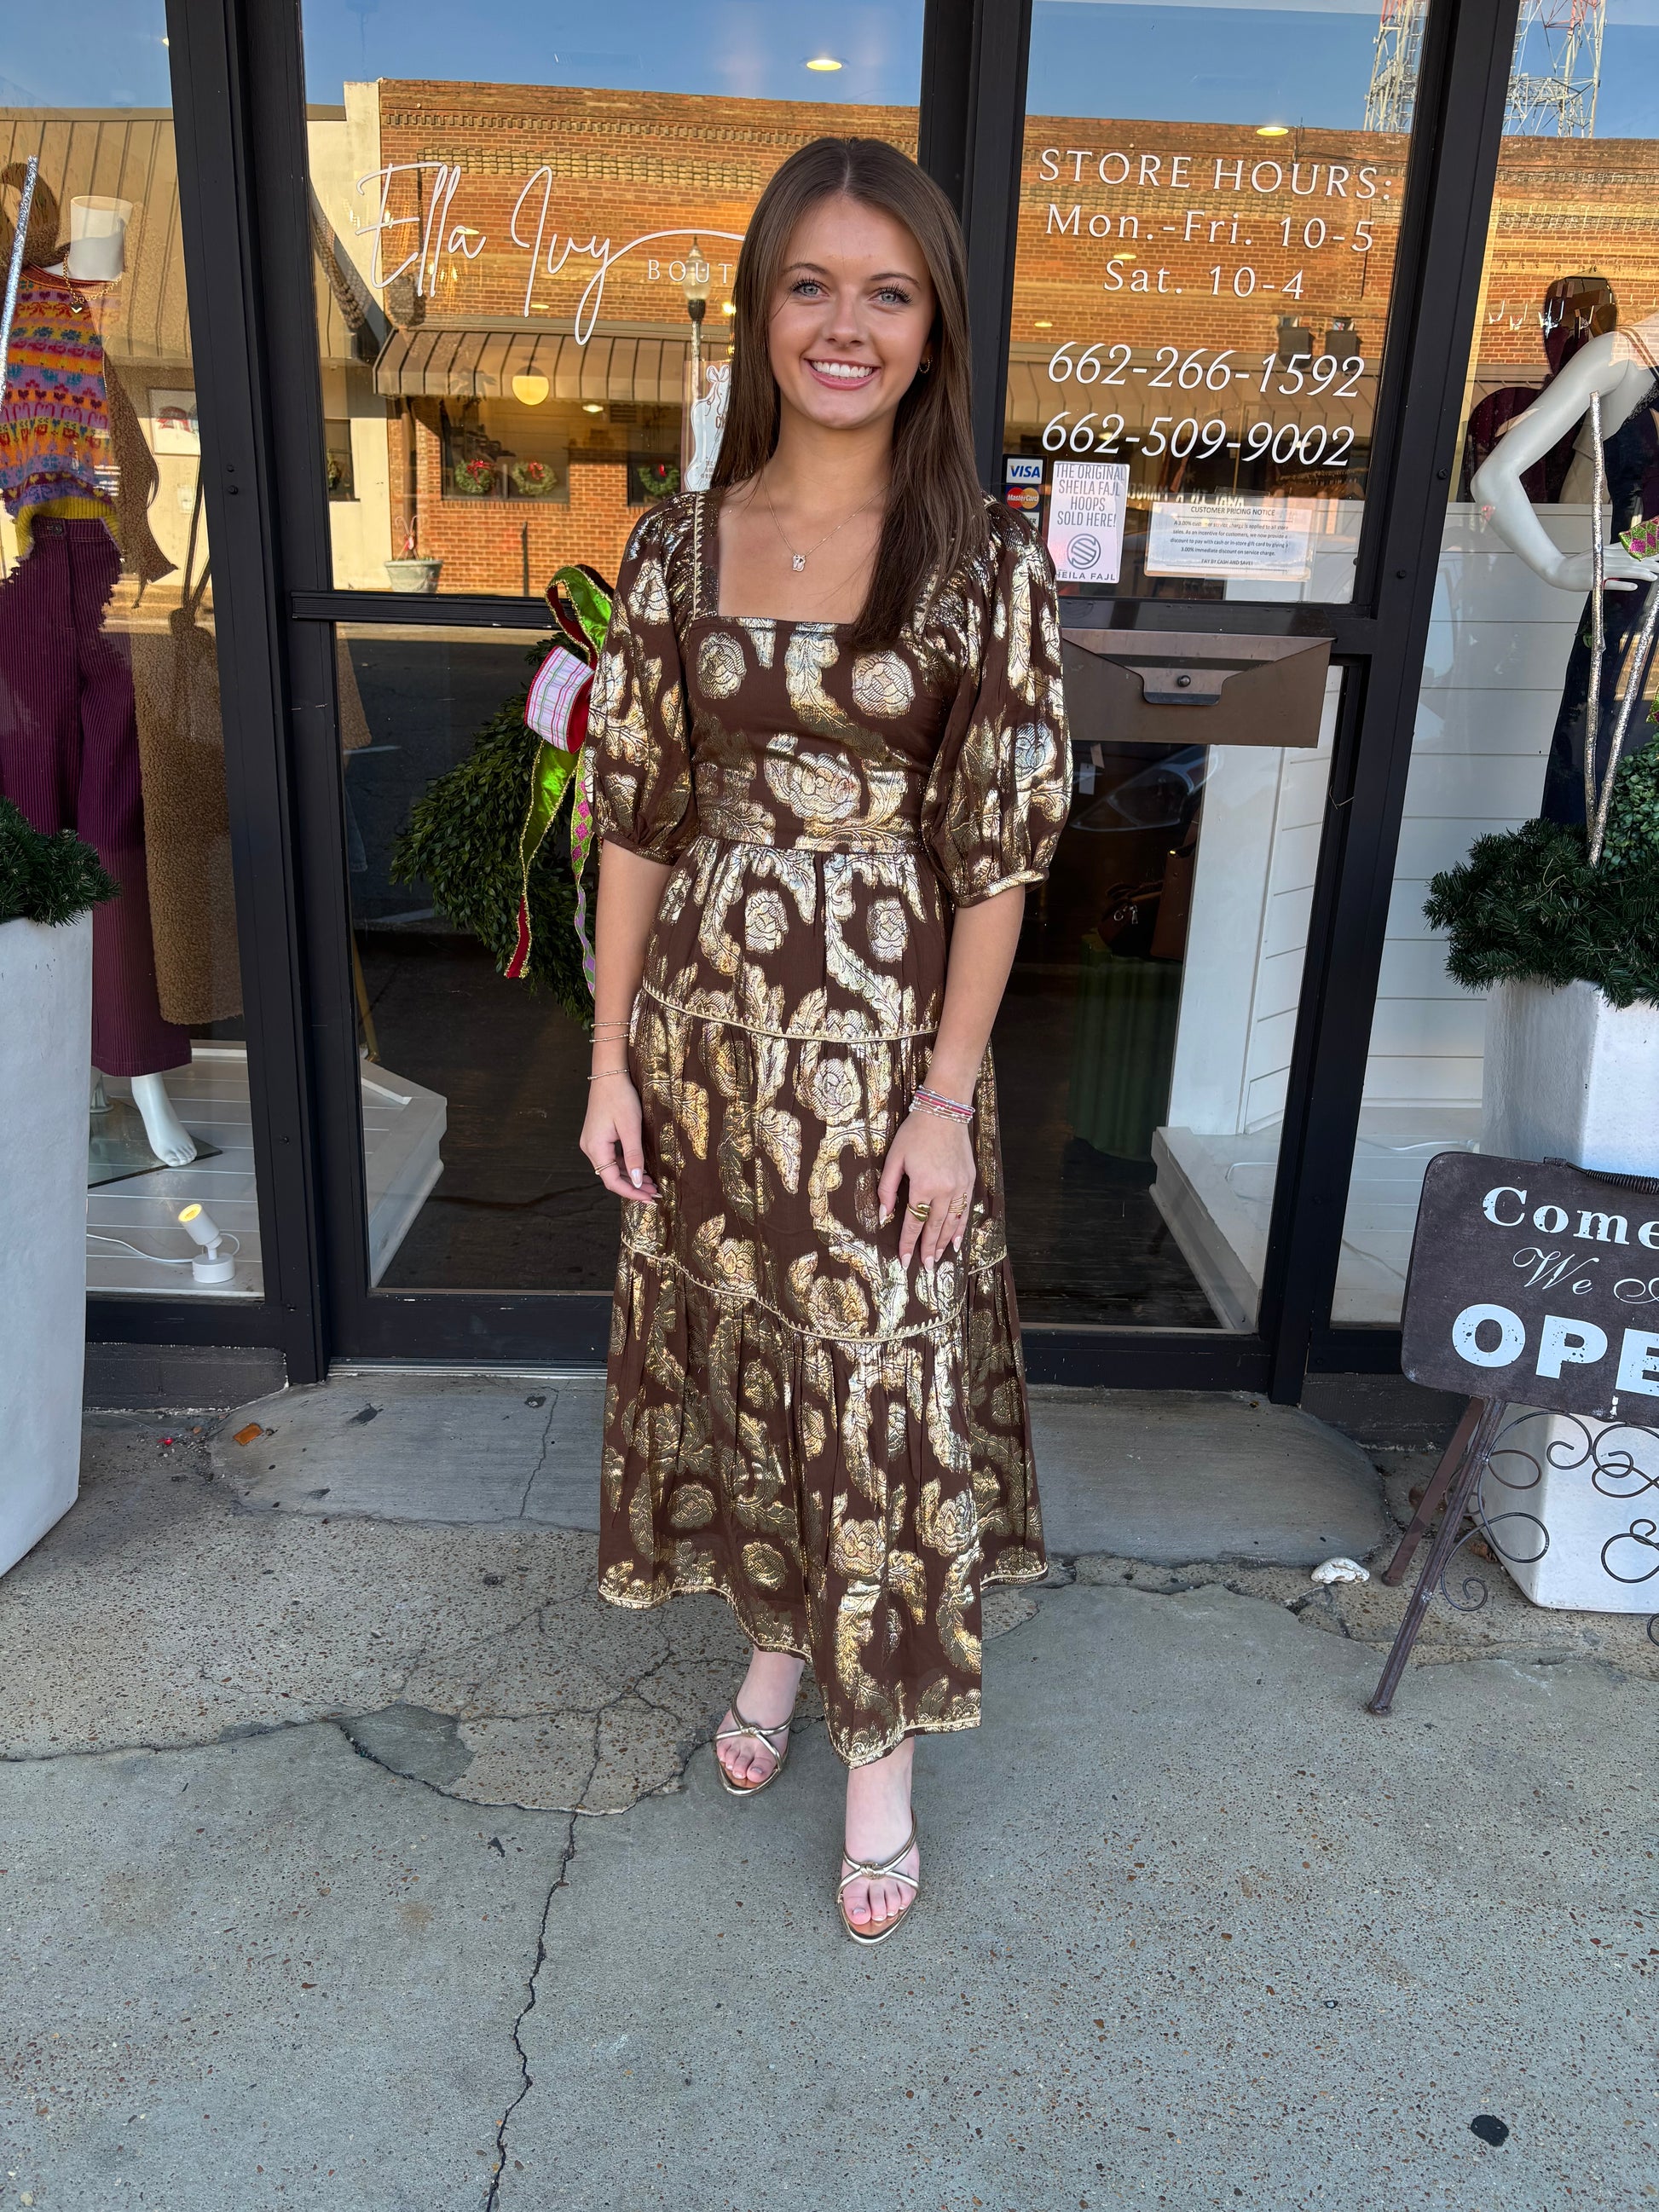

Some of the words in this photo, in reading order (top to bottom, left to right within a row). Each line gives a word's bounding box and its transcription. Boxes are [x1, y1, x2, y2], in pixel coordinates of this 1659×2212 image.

[1039, 148, 1192, 189] STORE
[1213, 159, 1392, 200] HOURS:
[356, 162, 486, 297] Ella
[1280, 217, 1375, 252] 10-5
[648, 258, 734, 284] BOUT
[1104, 259, 1182, 294] Sat.
[1210, 266, 1304, 300] 10-4
[1048, 341, 1365, 398] 662-266-1592
[1042, 411, 1356, 467] 662-509-9002
[1010, 465, 1040, 478] VISA
[1056, 463, 1074, 478] THE
[1078, 465, 1124, 481] ORIGINAL
[1059, 480, 1095, 495] SHEILA
[1098, 482, 1120, 496] FAJL
[1057, 511, 1083, 526] SOLD
[1086, 512, 1117, 528] HERE!
[1071, 496, 1105, 511] HOOPS
[1055, 571, 1086, 580] HEILA
[1483, 1186, 1659, 1250] Come
[1512, 1247, 1599, 1295] We
[1452, 1303, 1659, 1397] OPE
